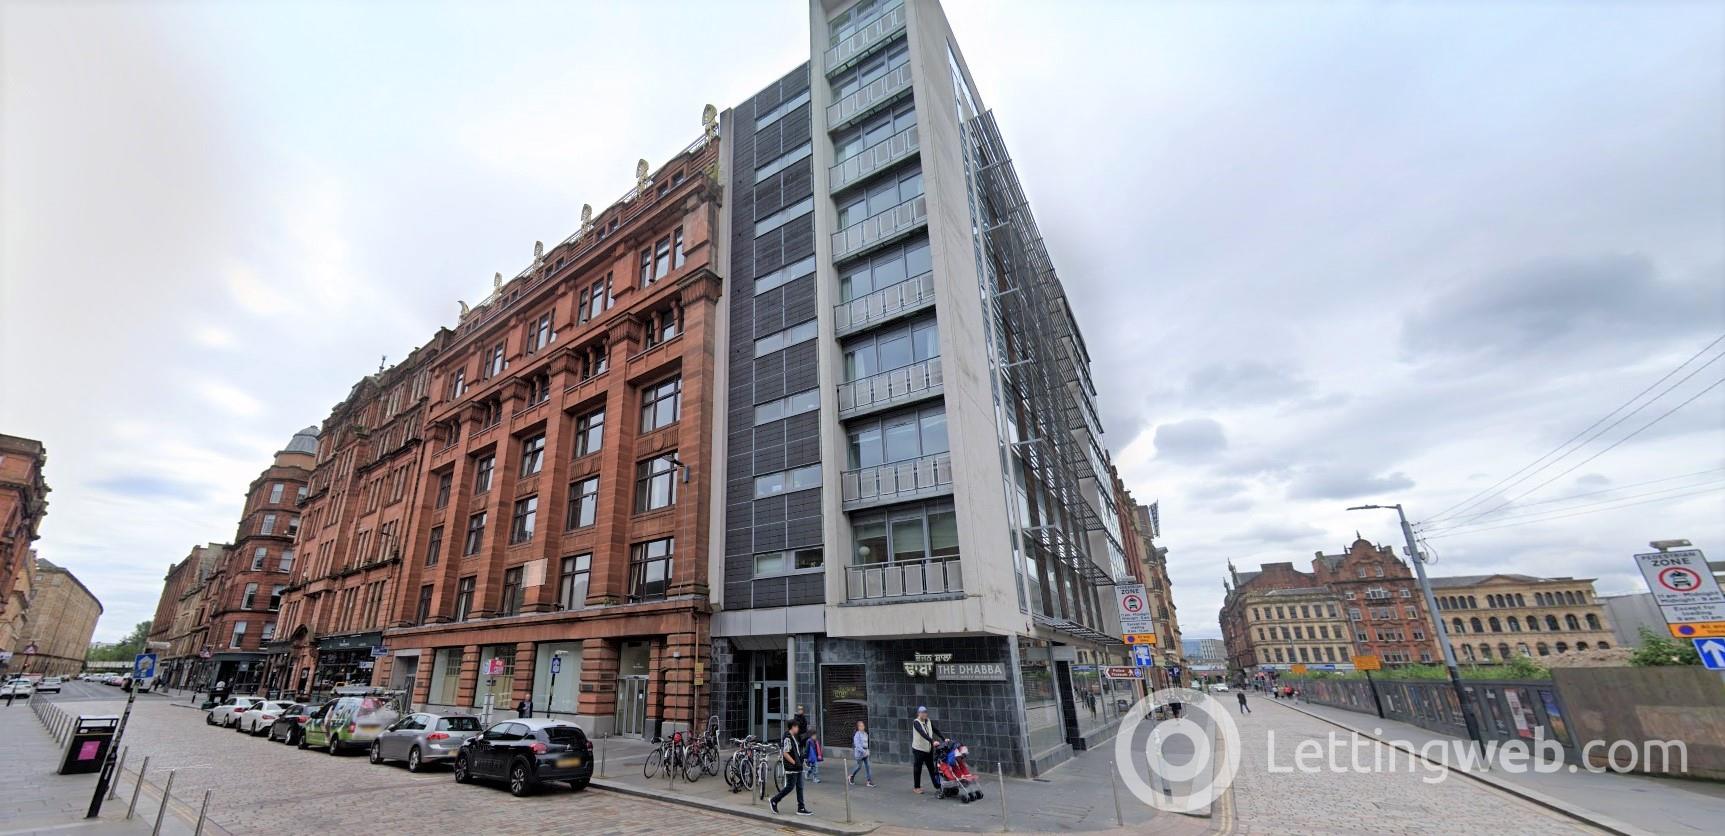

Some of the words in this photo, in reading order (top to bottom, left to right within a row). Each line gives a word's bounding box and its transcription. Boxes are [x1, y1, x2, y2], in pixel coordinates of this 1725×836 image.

[1651, 557, 1692, 567] ZONE
[938, 665, 956, 674] THE
[959, 664, 1002, 674] DHABBA
